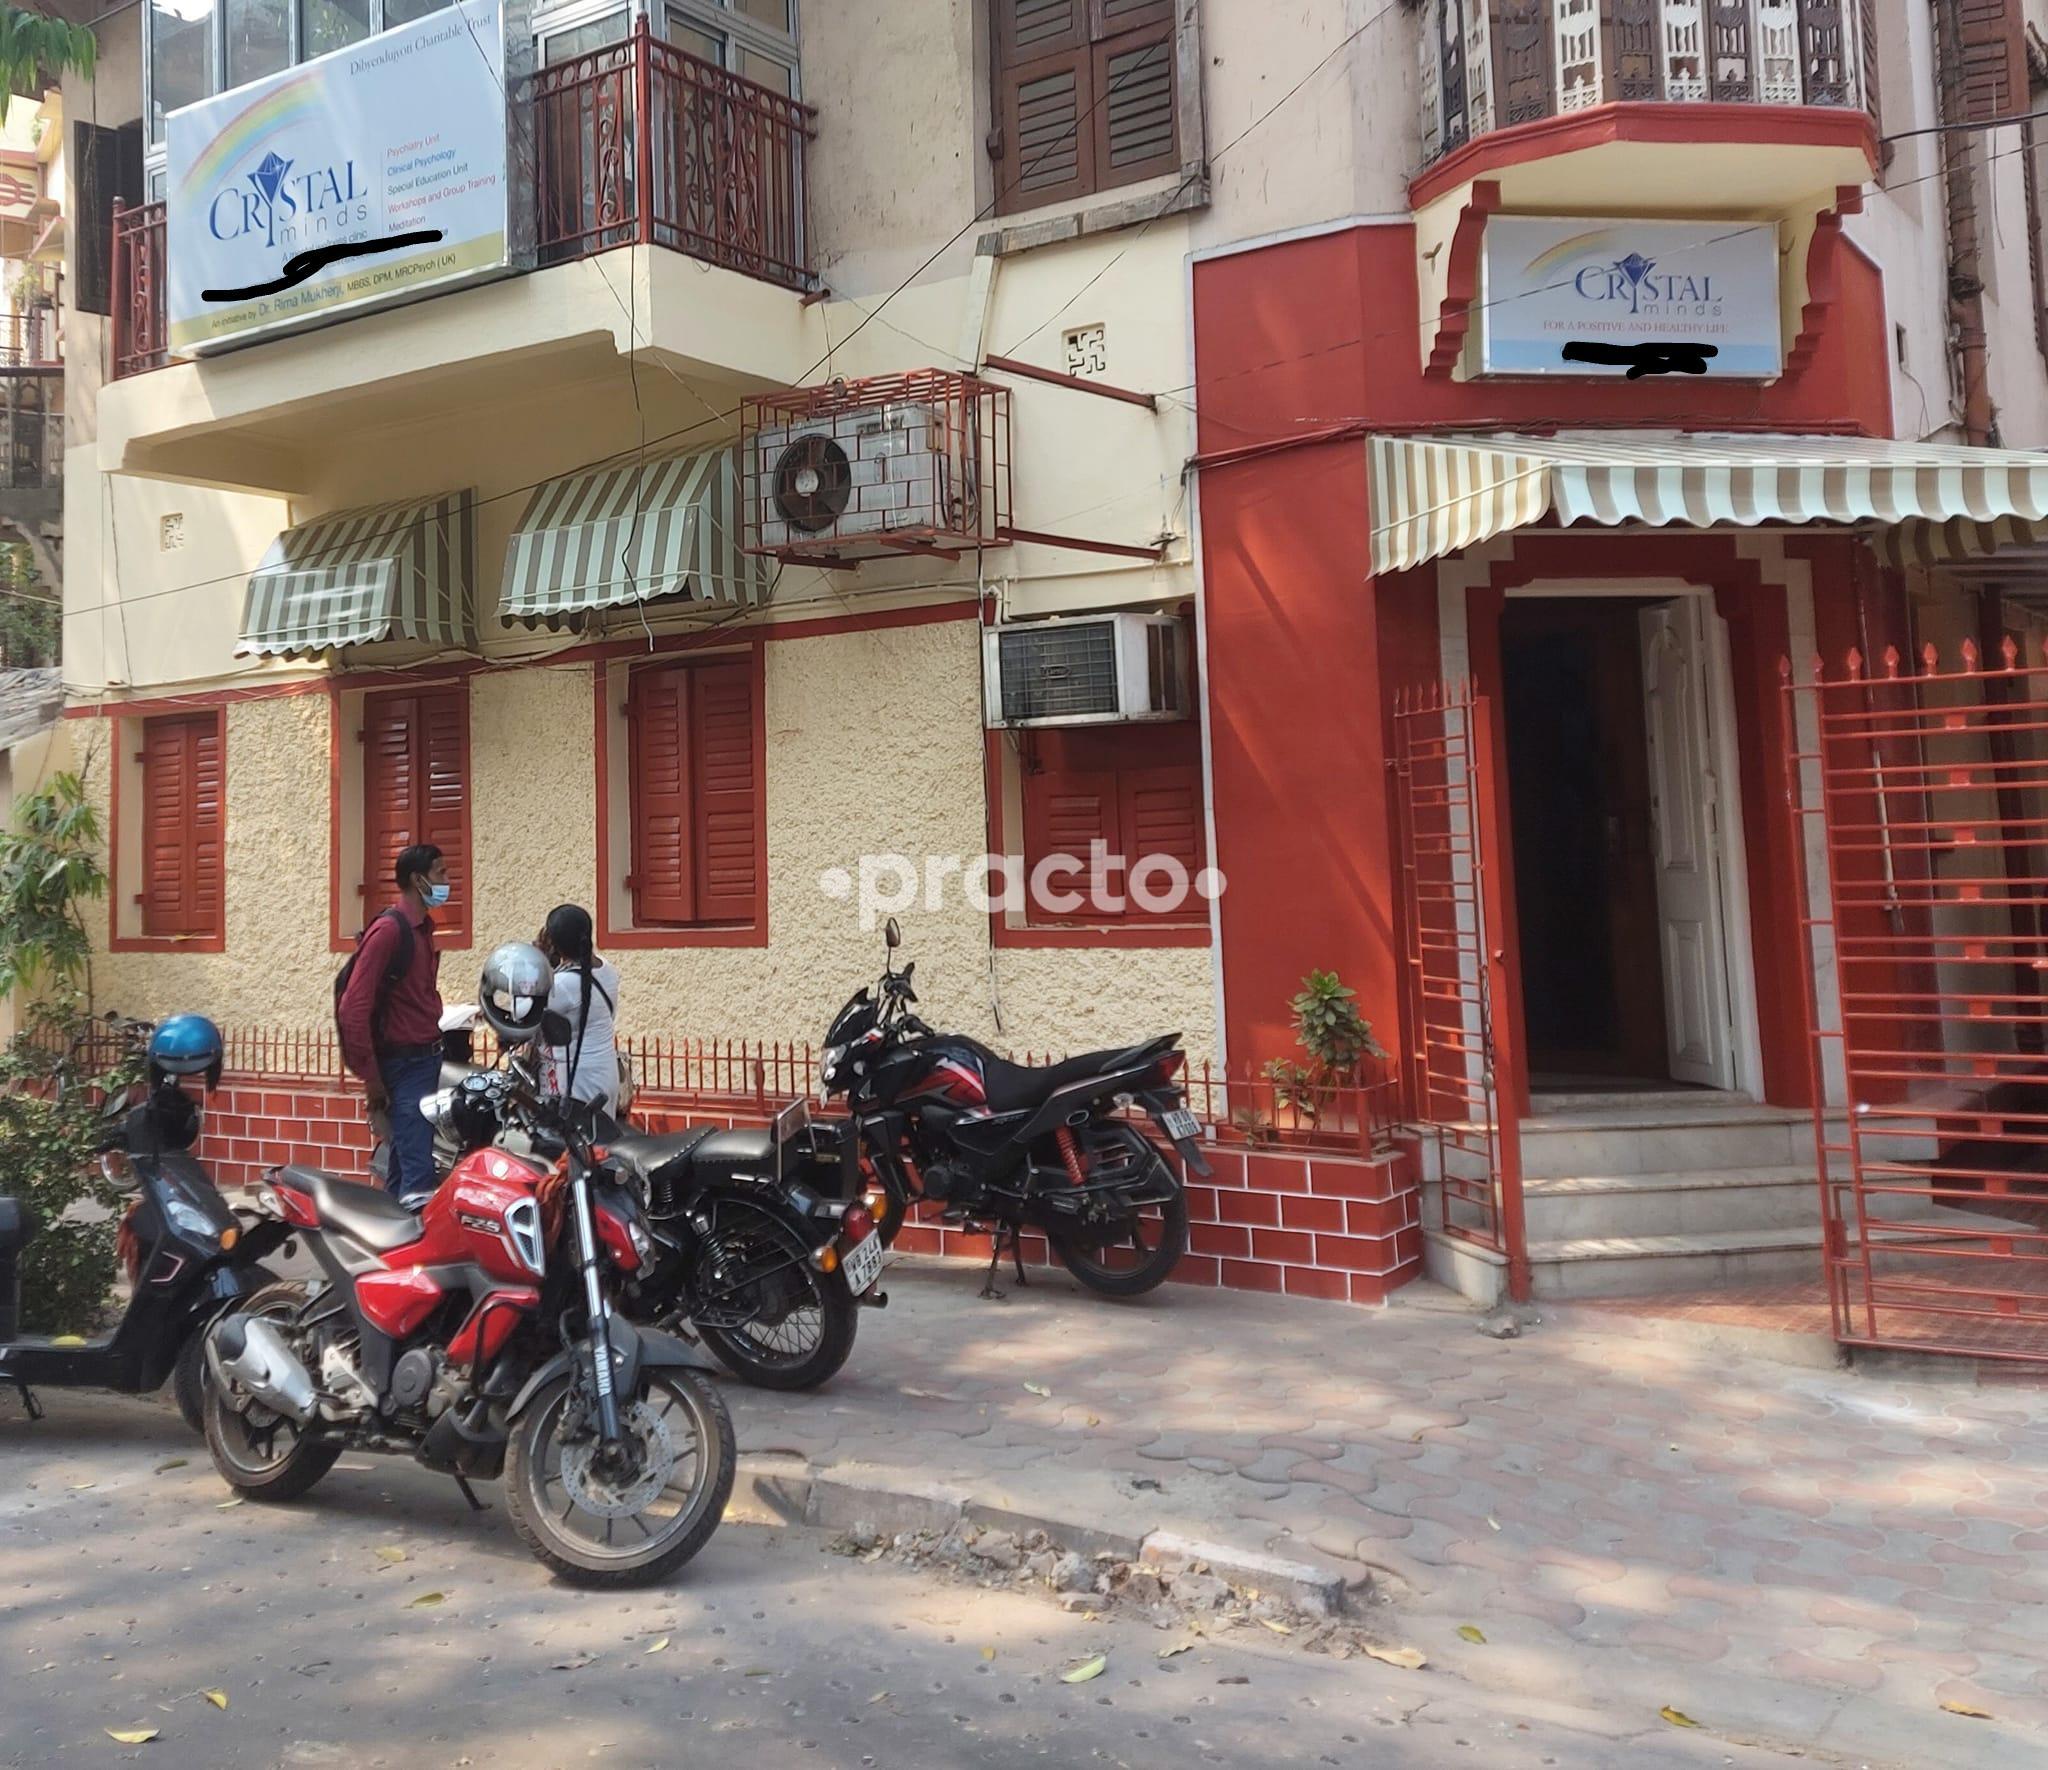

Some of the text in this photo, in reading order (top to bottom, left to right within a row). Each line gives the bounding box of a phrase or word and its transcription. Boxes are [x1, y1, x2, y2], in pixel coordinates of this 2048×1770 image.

[386, 133, 440, 158] Psychiatry Unit
[387, 149, 457, 176] Clinical Psychology
[387, 162, 468, 196] Special Education Unit
[388, 174, 496, 214] Workshops and Group Training
[209, 151, 368, 247] CRYSTAL
[280, 203, 368, 244] minds
[388, 215, 426, 232] Meditation
[274, 296, 298, 311] Rima
[395, 259, 437, 278] MRCPsych
[1575, 252, 1724, 314] CRYSTAL
[1544, 320, 1729, 333] FOR A POSITIVE AND HEALTHY LIFE
[1643, 302, 1723, 317] minds
[594, 1344, 611, 1397] YAMAHA
